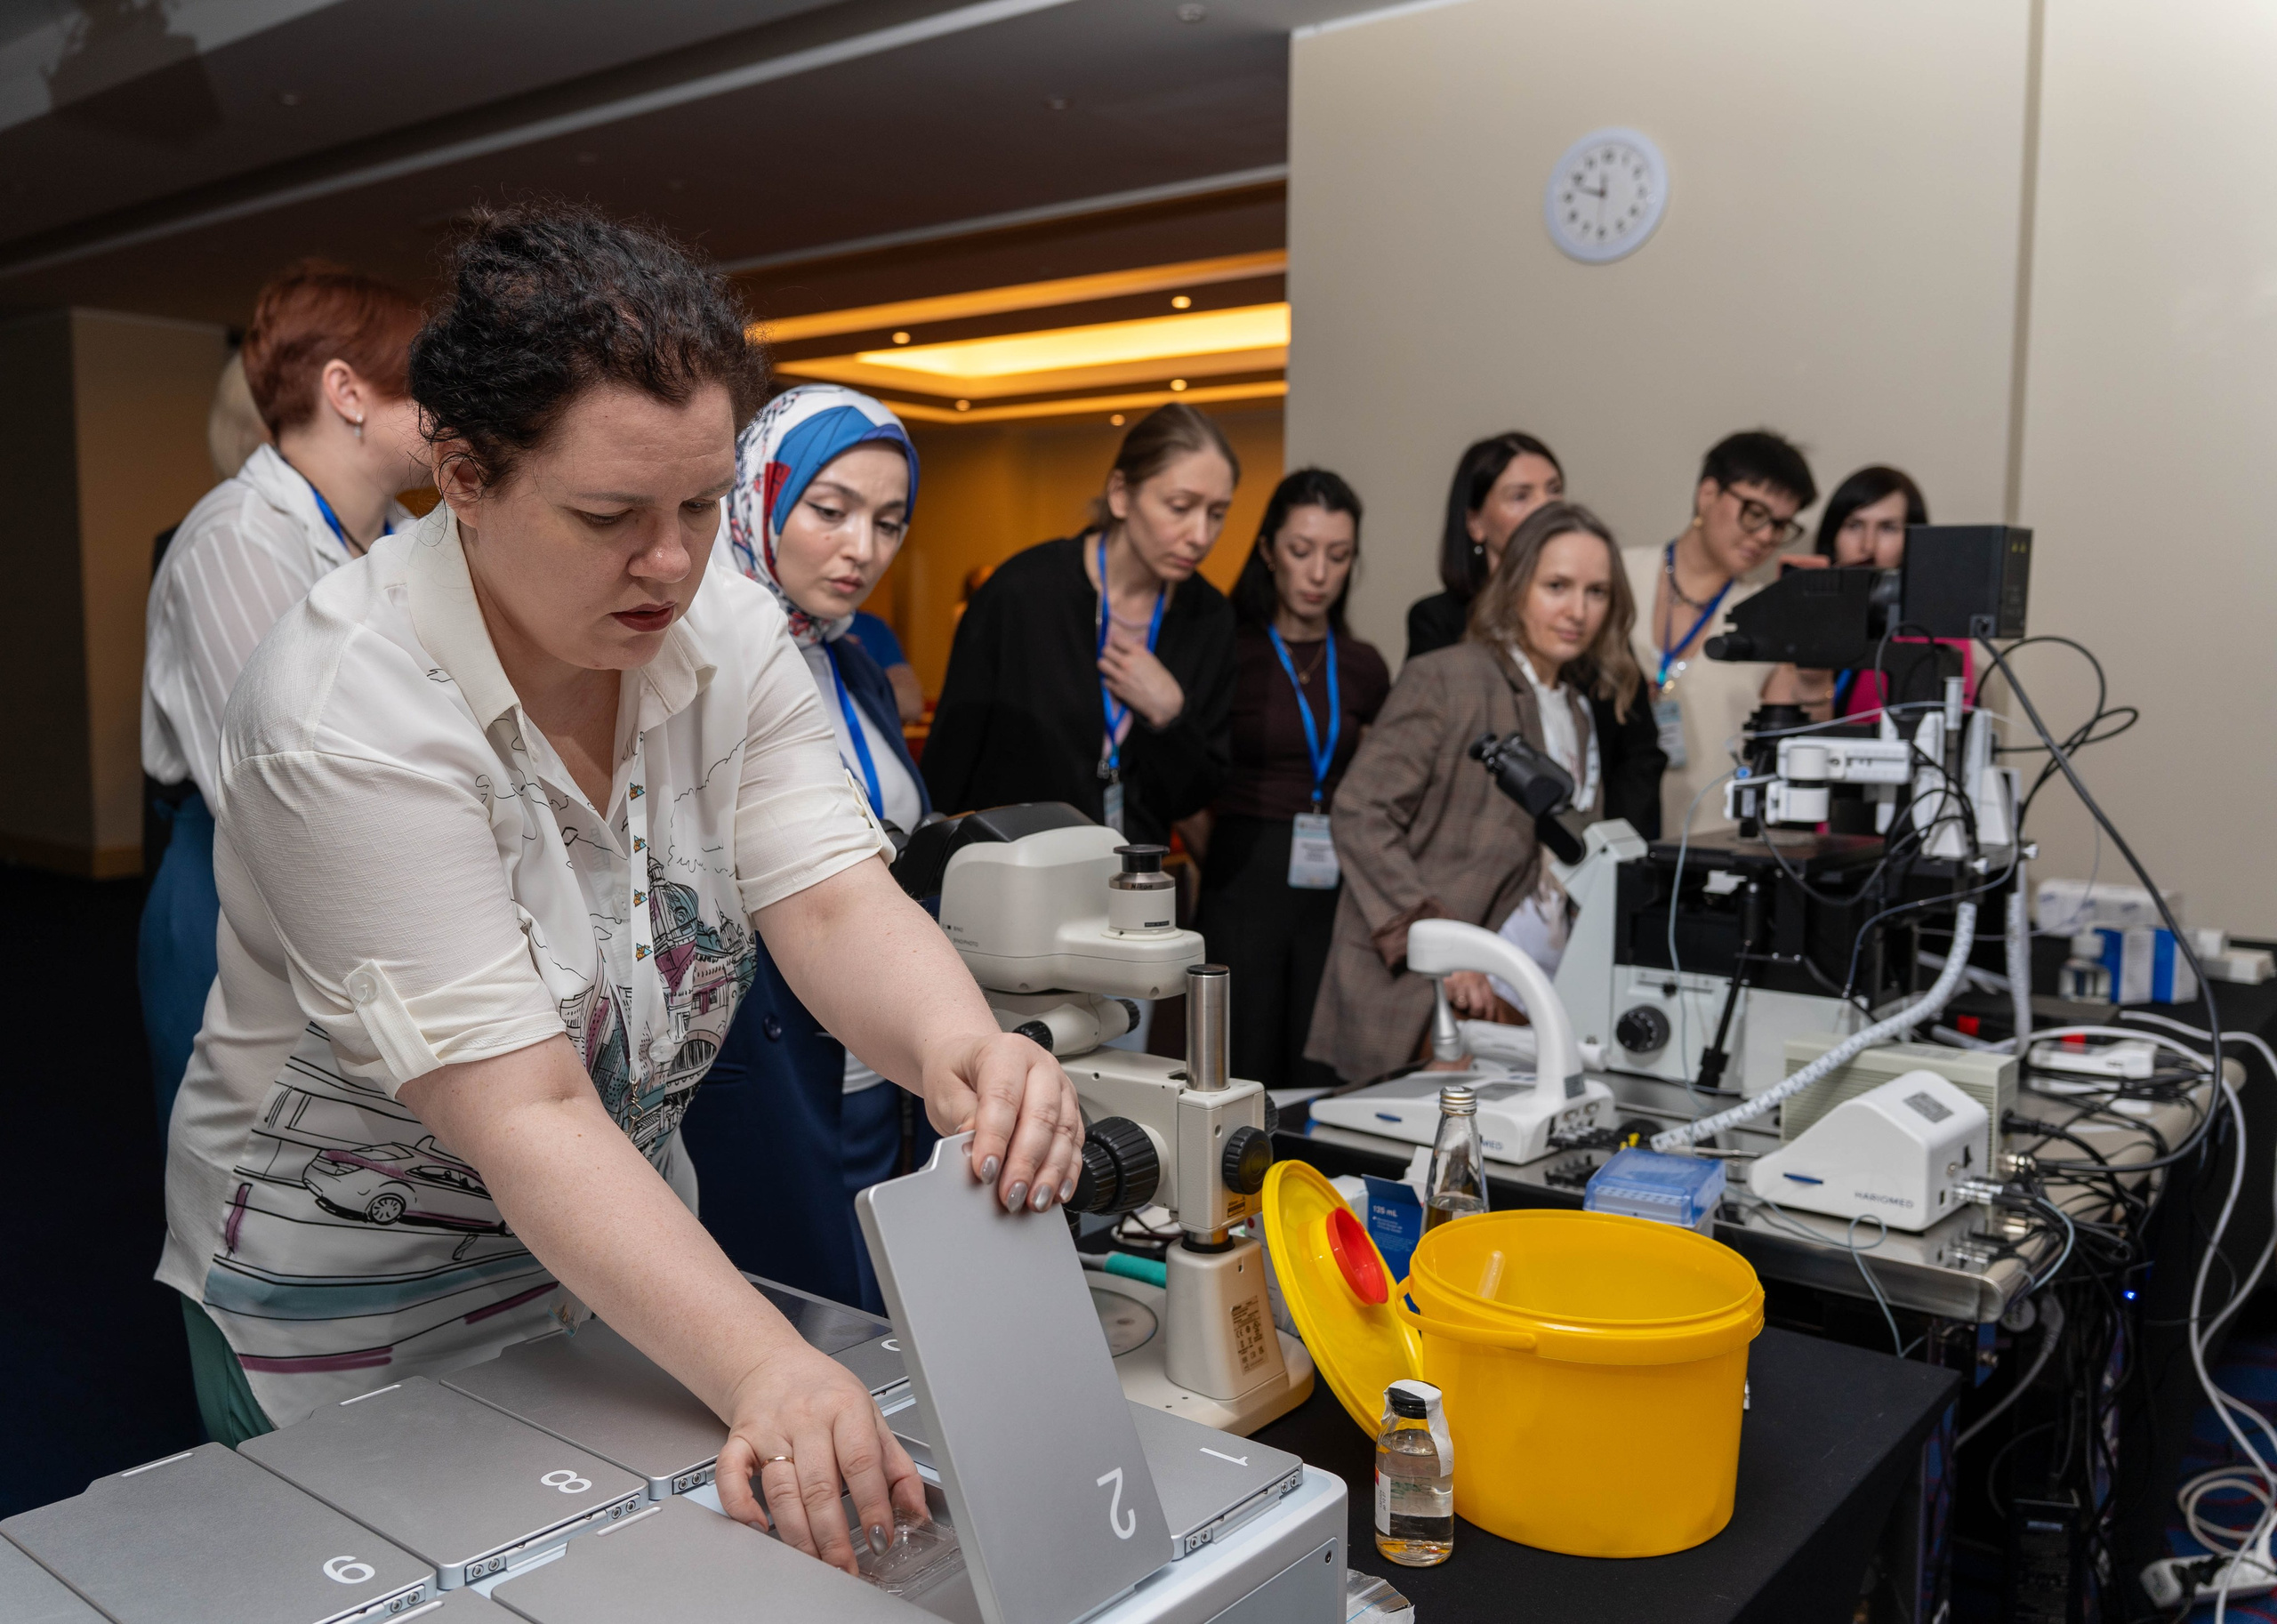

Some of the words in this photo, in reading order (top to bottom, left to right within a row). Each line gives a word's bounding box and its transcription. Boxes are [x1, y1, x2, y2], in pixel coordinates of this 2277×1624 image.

[1854, 1191, 1914, 1210] HARIOMED
[1199, 1447, 1249, 1467] 1
[540, 1469, 592, 1494] 8
[1096, 1467, 1137, 1540] 2
